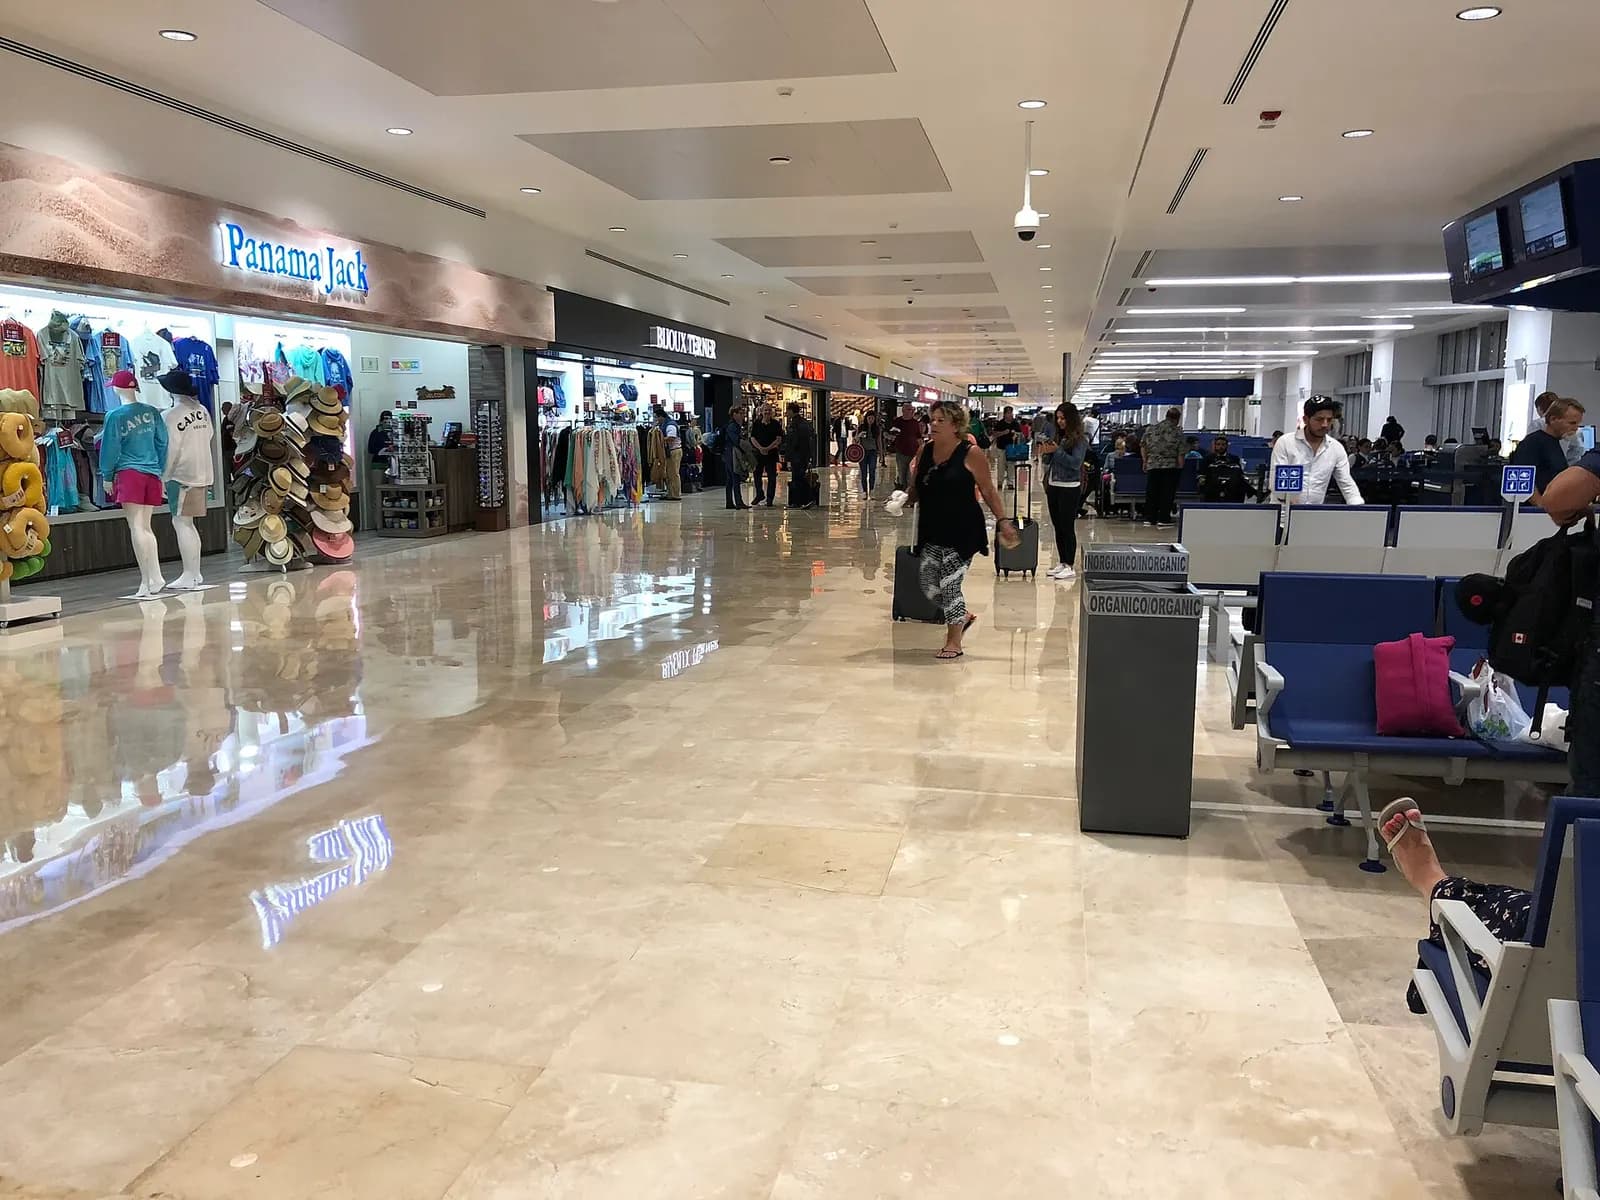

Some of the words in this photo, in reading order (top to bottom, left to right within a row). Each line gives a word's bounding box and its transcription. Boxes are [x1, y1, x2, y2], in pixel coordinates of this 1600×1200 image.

[226, 223, 321, 281] Panama
[325, 247, 369, 293] Jack
[656, 326, 687, 353] BIJOUX
[687, 333, 716, 359] TERNER
[121, 412, 155, 436] CANC
